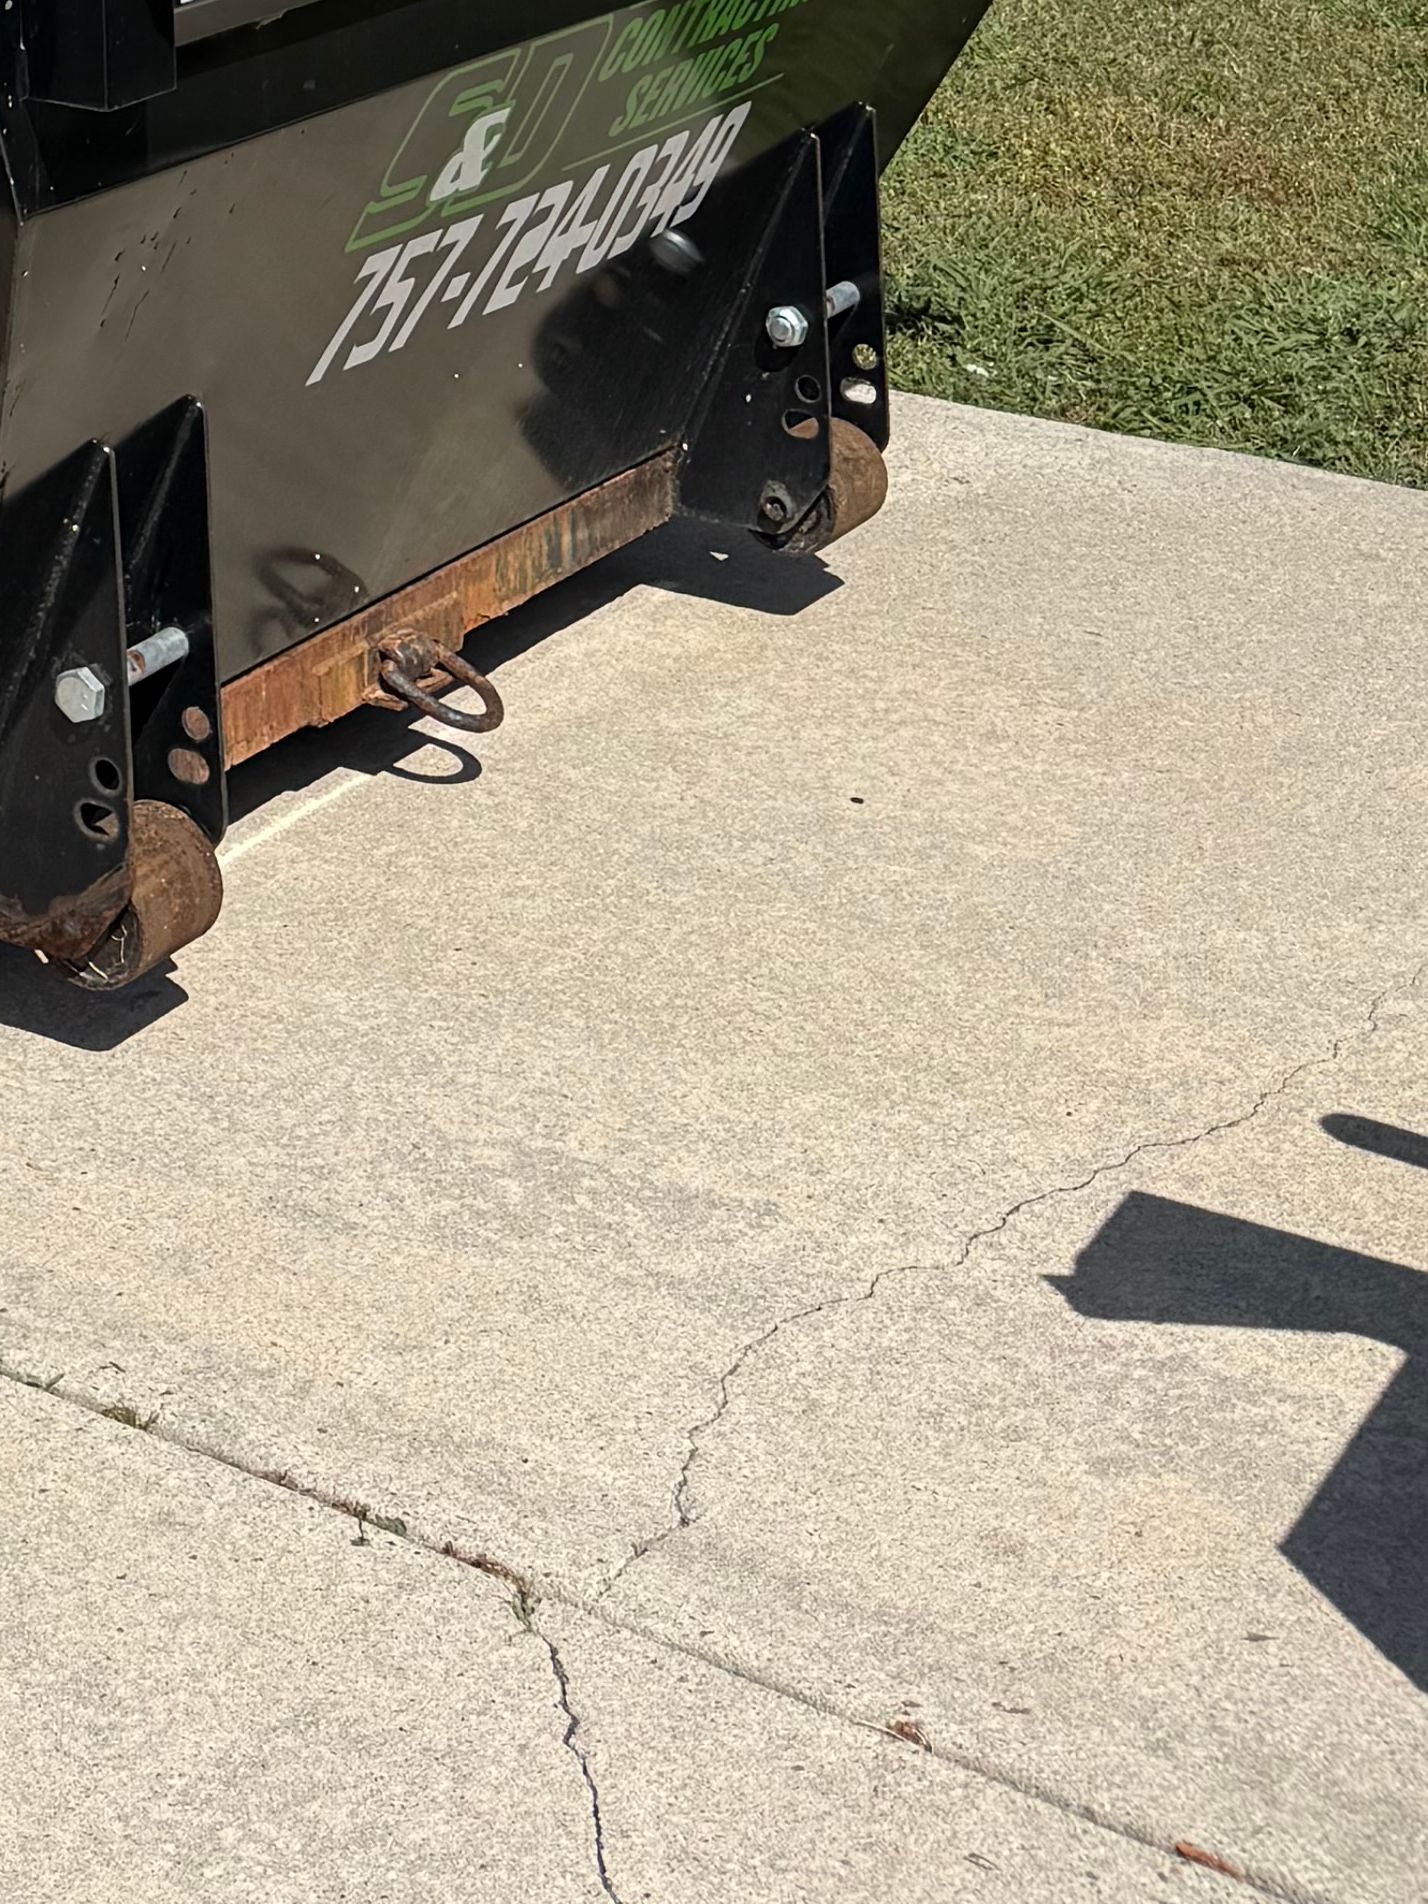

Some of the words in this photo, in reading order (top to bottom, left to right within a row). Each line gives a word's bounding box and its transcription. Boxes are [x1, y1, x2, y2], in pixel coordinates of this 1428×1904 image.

[345, 14, 615, 254] S&D
[608, 23, 781, 138] SERVICES
[305, 100, 752, 387] 757-724-0349
